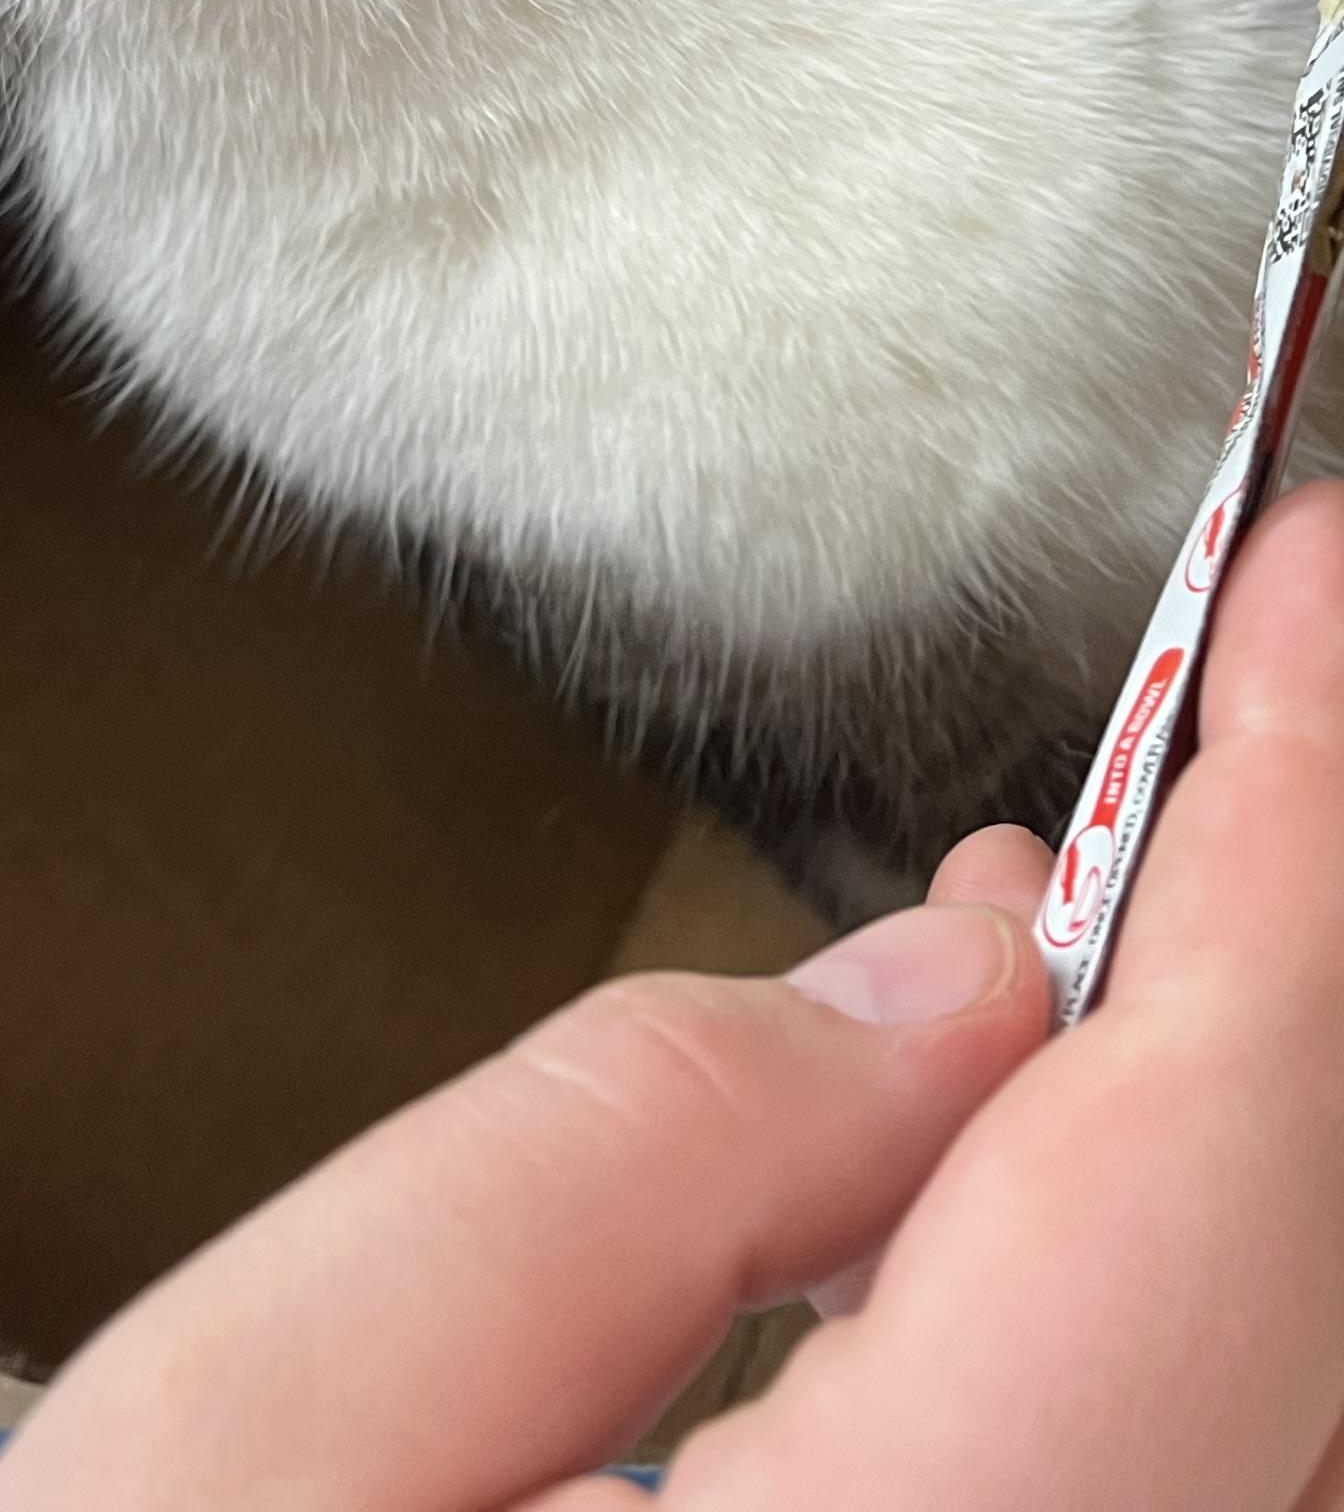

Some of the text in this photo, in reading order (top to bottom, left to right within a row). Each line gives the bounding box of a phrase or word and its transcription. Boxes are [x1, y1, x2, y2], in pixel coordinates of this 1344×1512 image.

[1127, 677, 1170, 734] BOWL
[1120, 736, 1136, 751] A
[1104, 754, 1128, 804] INTO
